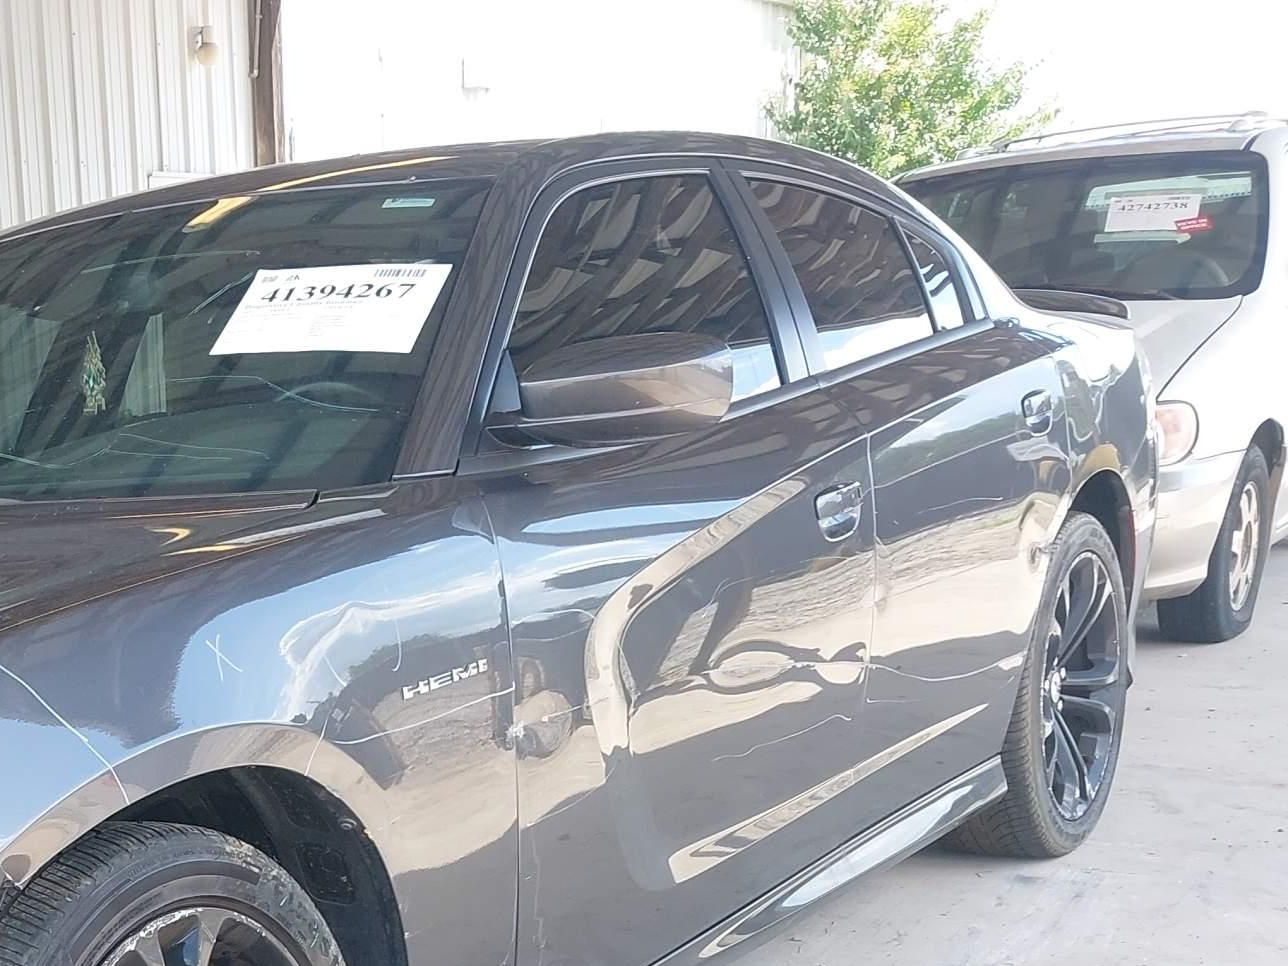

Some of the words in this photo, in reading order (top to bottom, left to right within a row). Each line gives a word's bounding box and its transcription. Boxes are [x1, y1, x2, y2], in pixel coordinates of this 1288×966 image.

[1118, 202, 1189, 211] 42742738
[260, 282, 417, 303] 41394267
[401, 658, 488, 700] HEMI
